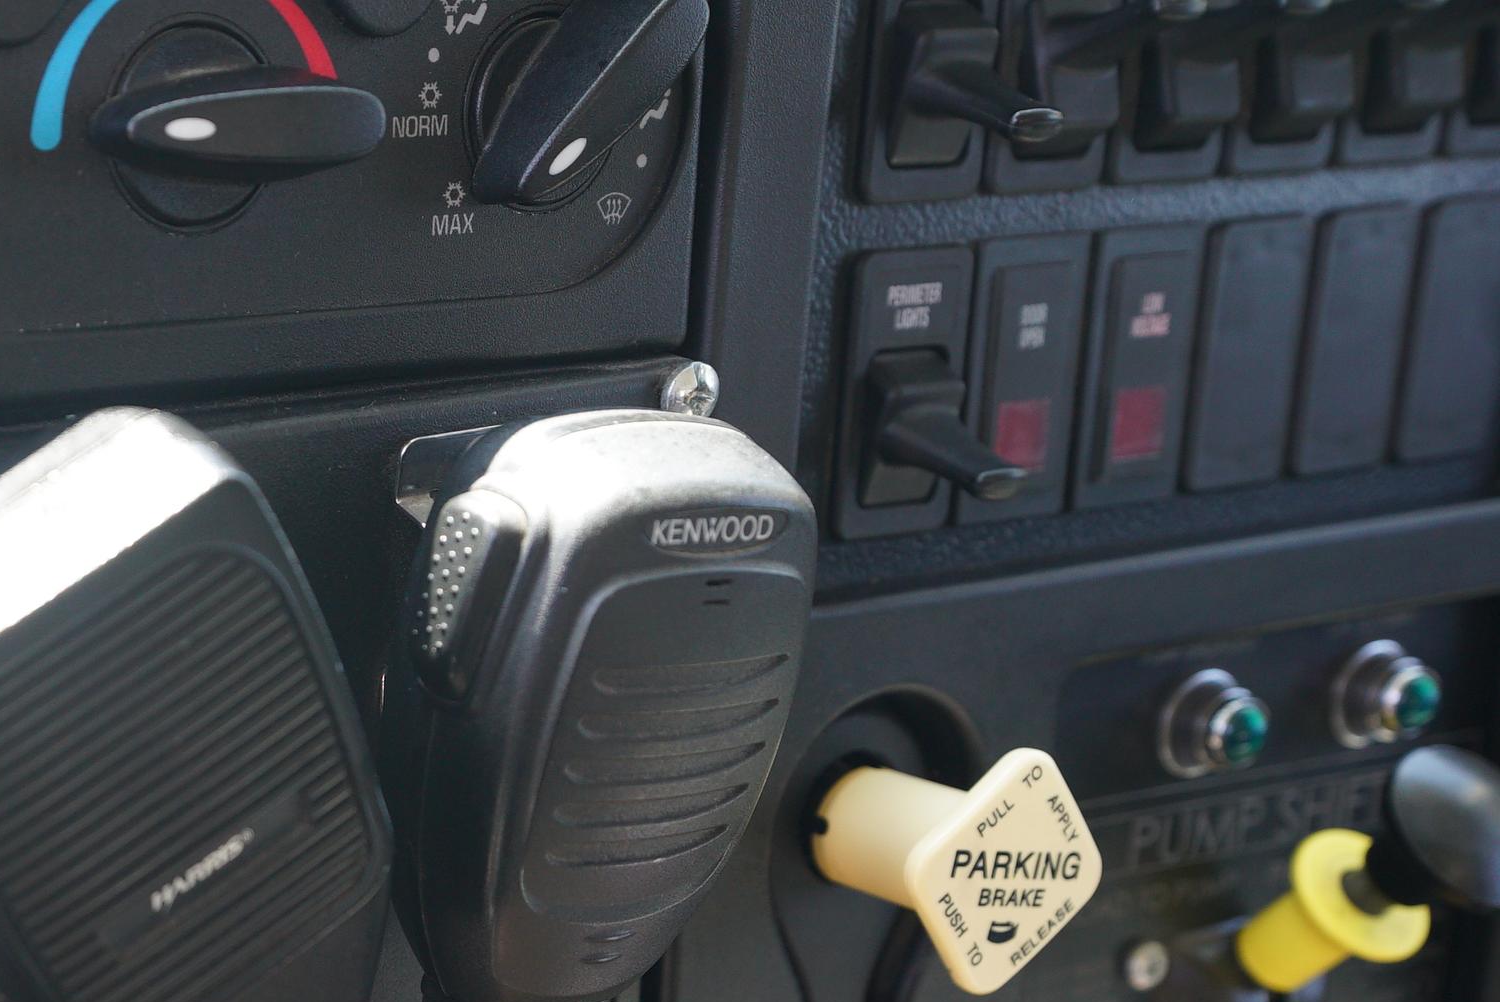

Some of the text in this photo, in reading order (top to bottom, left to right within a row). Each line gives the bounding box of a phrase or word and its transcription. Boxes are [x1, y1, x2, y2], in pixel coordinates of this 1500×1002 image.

[392, 114, 448, 138] NORM
[431, 212, 475, 236] MAX
[651, 514, 774, 546] KENWOOD
[976, 765, 1080, 842] PULL TO APPLY
[950, 849, 1082, 880] PARKING
[977, 888, 1046, 907] BRAKE
[938, 893, 1075, 968] PUSH TO RELEASE
